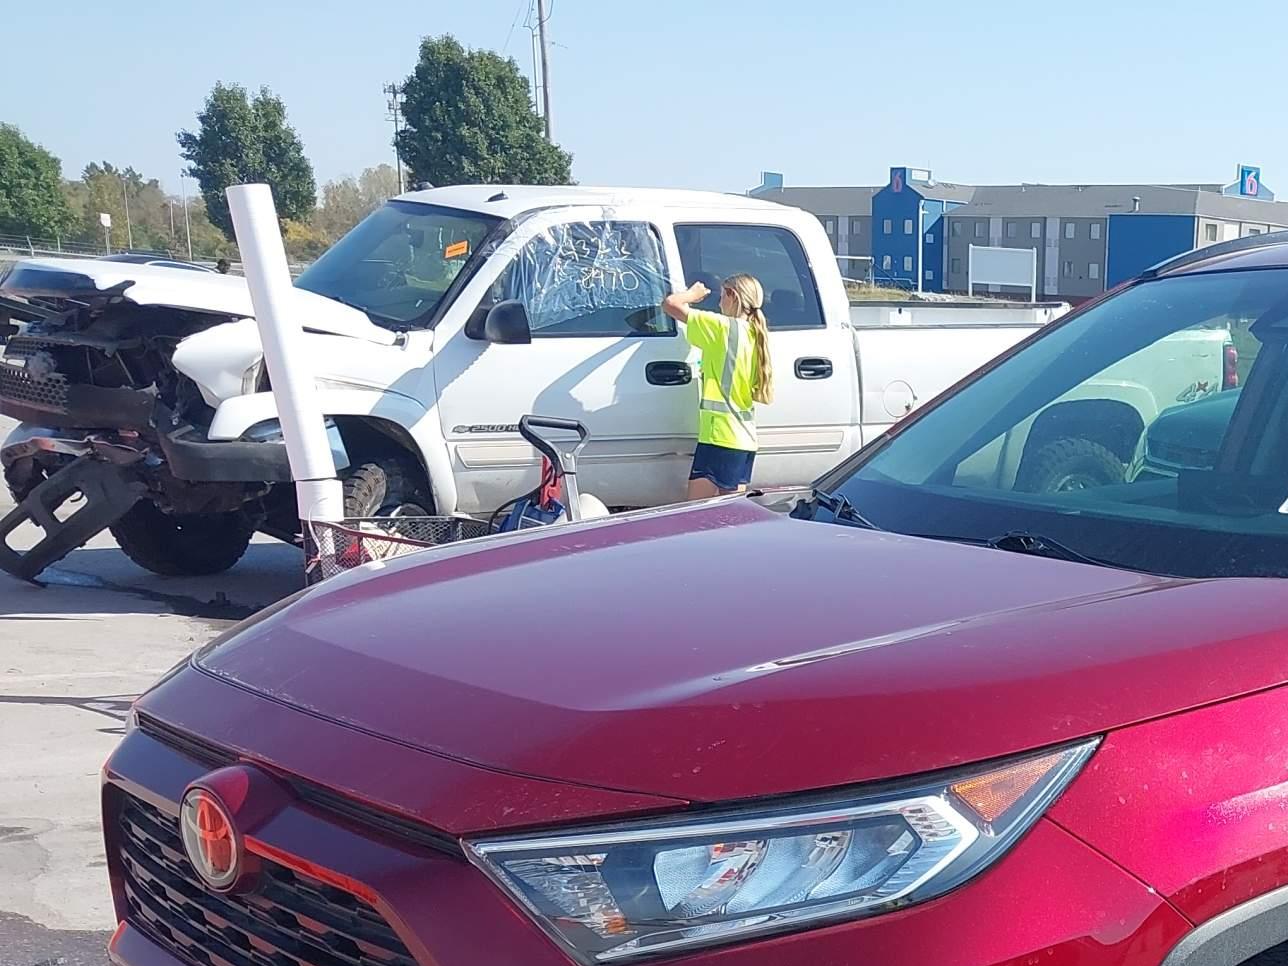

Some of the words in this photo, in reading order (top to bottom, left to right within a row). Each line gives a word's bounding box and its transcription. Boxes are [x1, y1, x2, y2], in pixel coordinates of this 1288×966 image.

[893, 172, 902, 192] 6
[1246, 171, 1258, 195] 6
[471, 424, 506, 433] 2500
